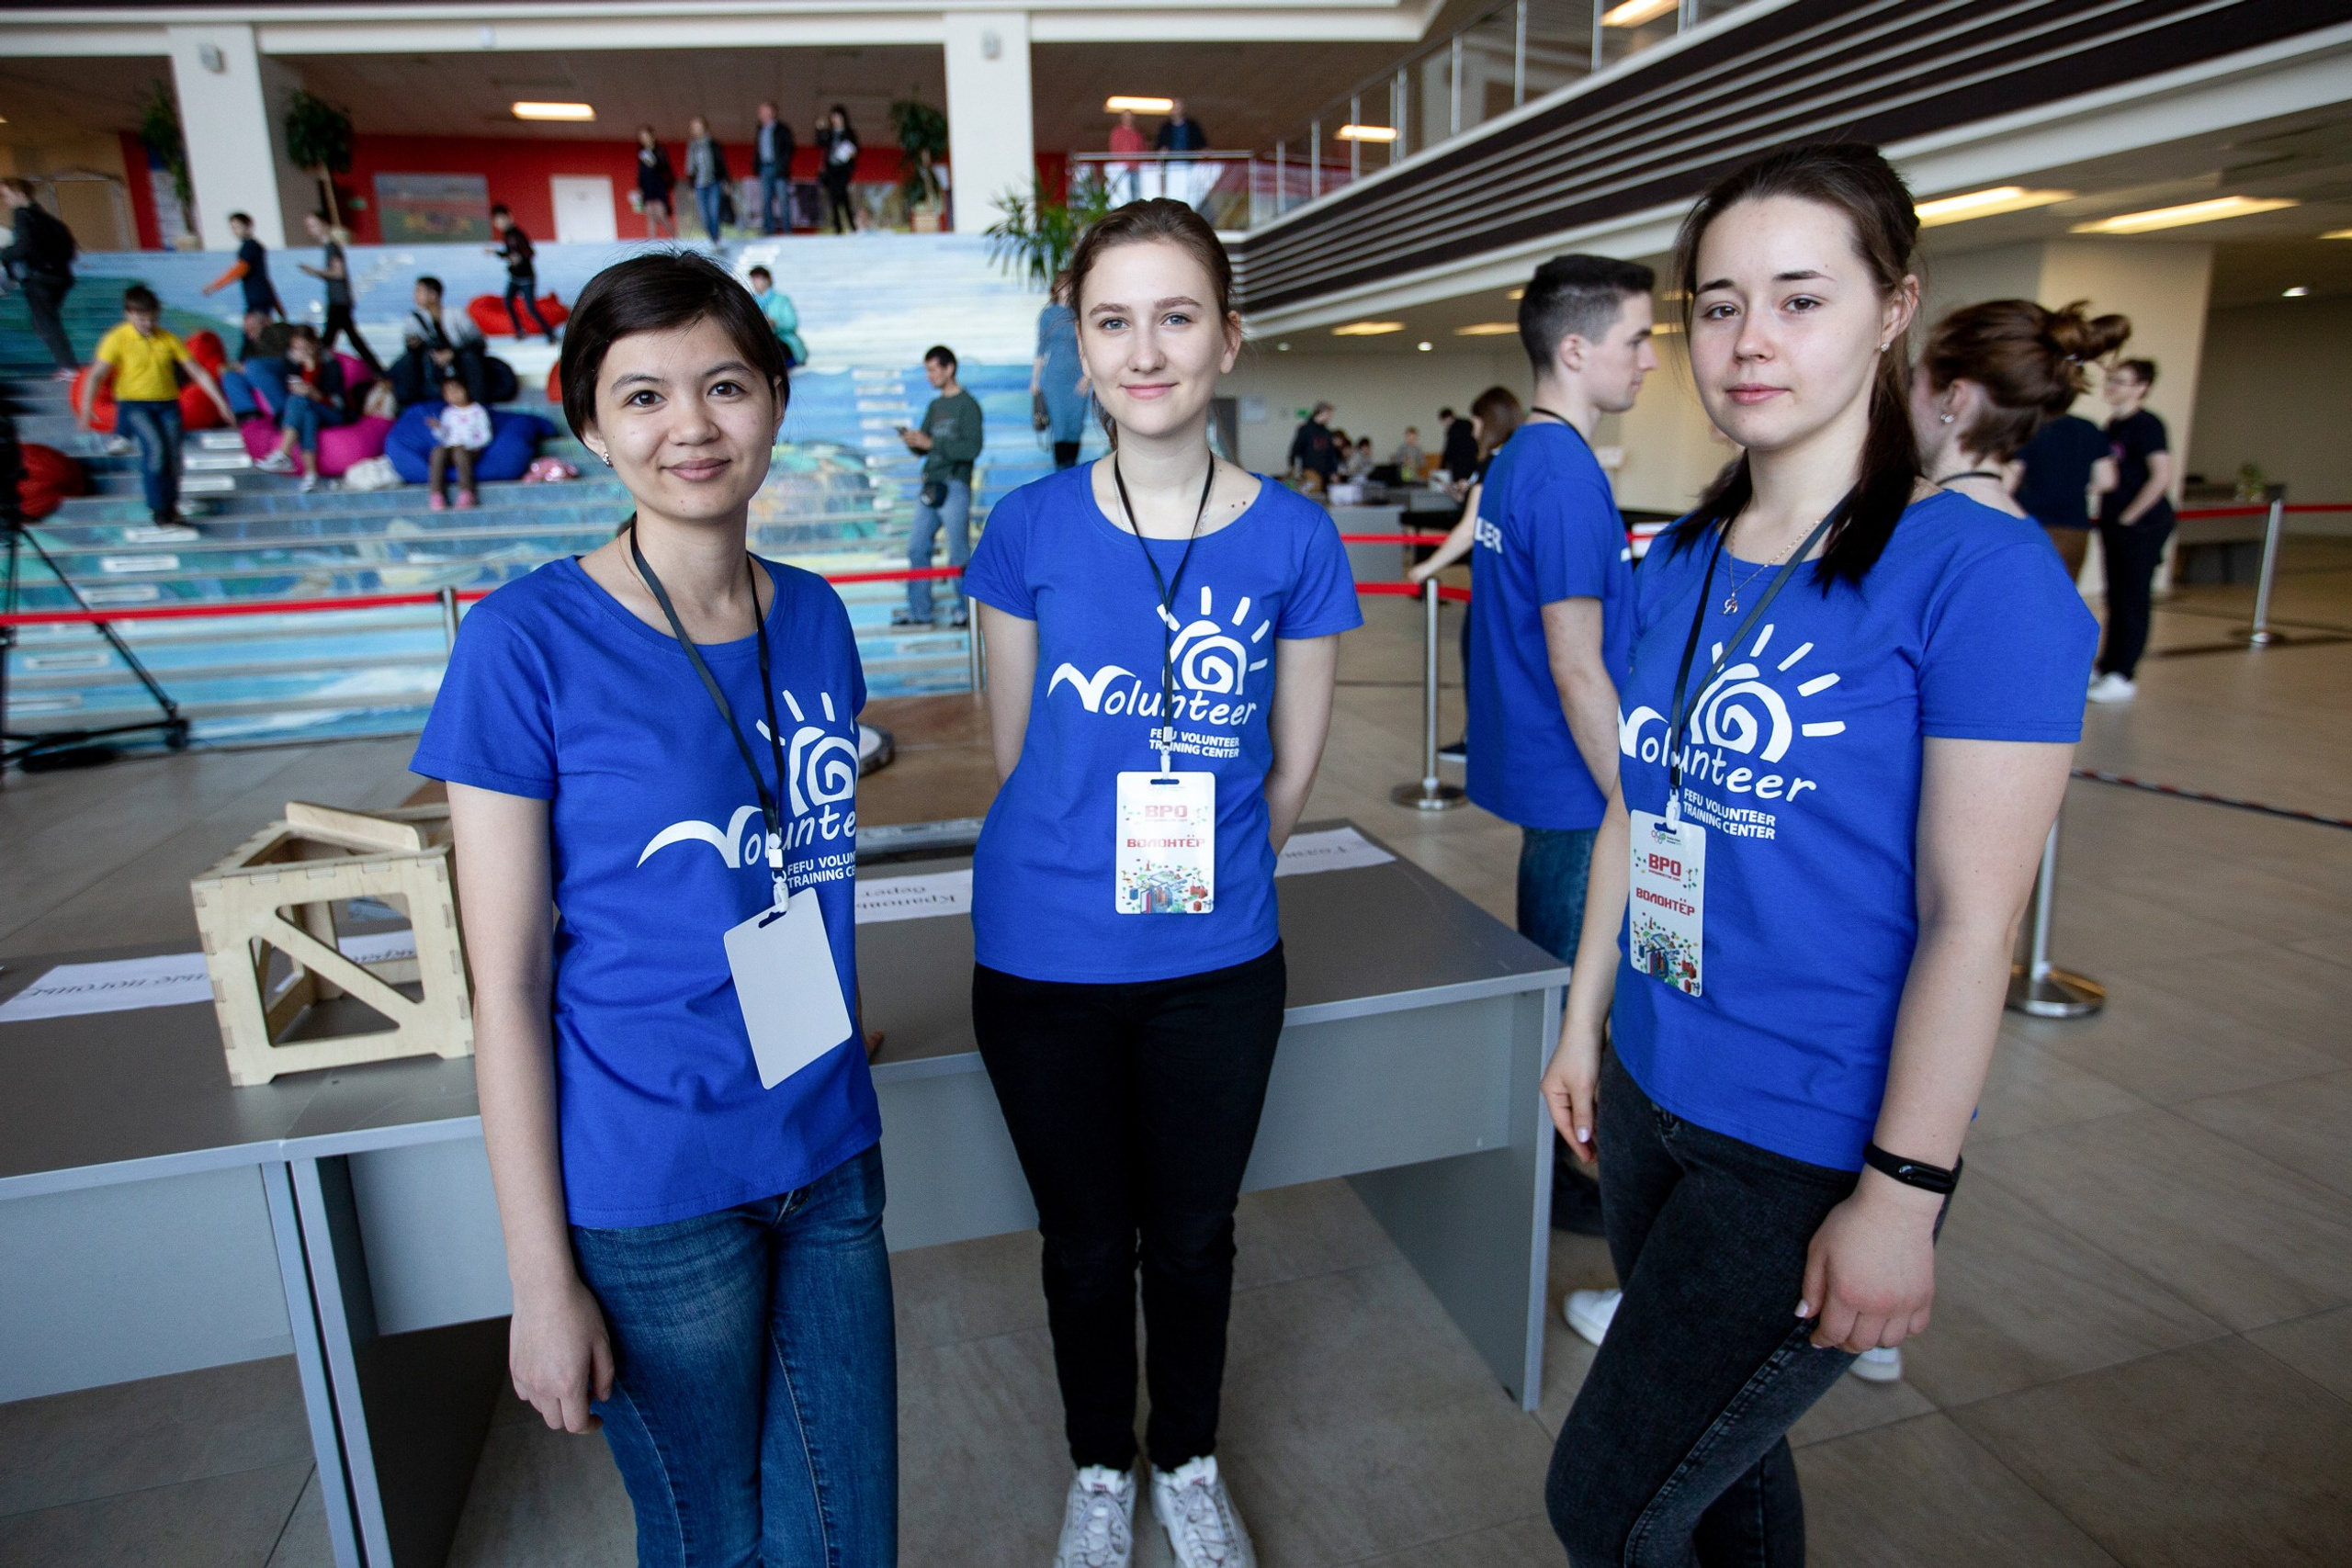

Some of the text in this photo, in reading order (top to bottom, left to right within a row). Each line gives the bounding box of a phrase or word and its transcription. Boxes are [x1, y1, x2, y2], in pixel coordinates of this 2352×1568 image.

[1047, 662, 1257, 726] Volunteer
[1149, 739, 1239, 759] TRINING CENTER
[1150, 728, 1239, 748] FEU VOLUNTEER
[1618, 704, 1817, 802] Volunteer
[1683, 788, 1776, 827] FEFU VOLUNTEER
[1683, 801, 1776, 840] TRAINING CENTER
[1126, 834, 1205, 848] ВОЛОНТЁР
[787, 858, 814, 876] FEFU
[1648, 852, 1681, 877] ВРО
[786, 867, 844, 889] TRAINING
[1635, 886, 1696, 917] ВОЛОНТЁР
